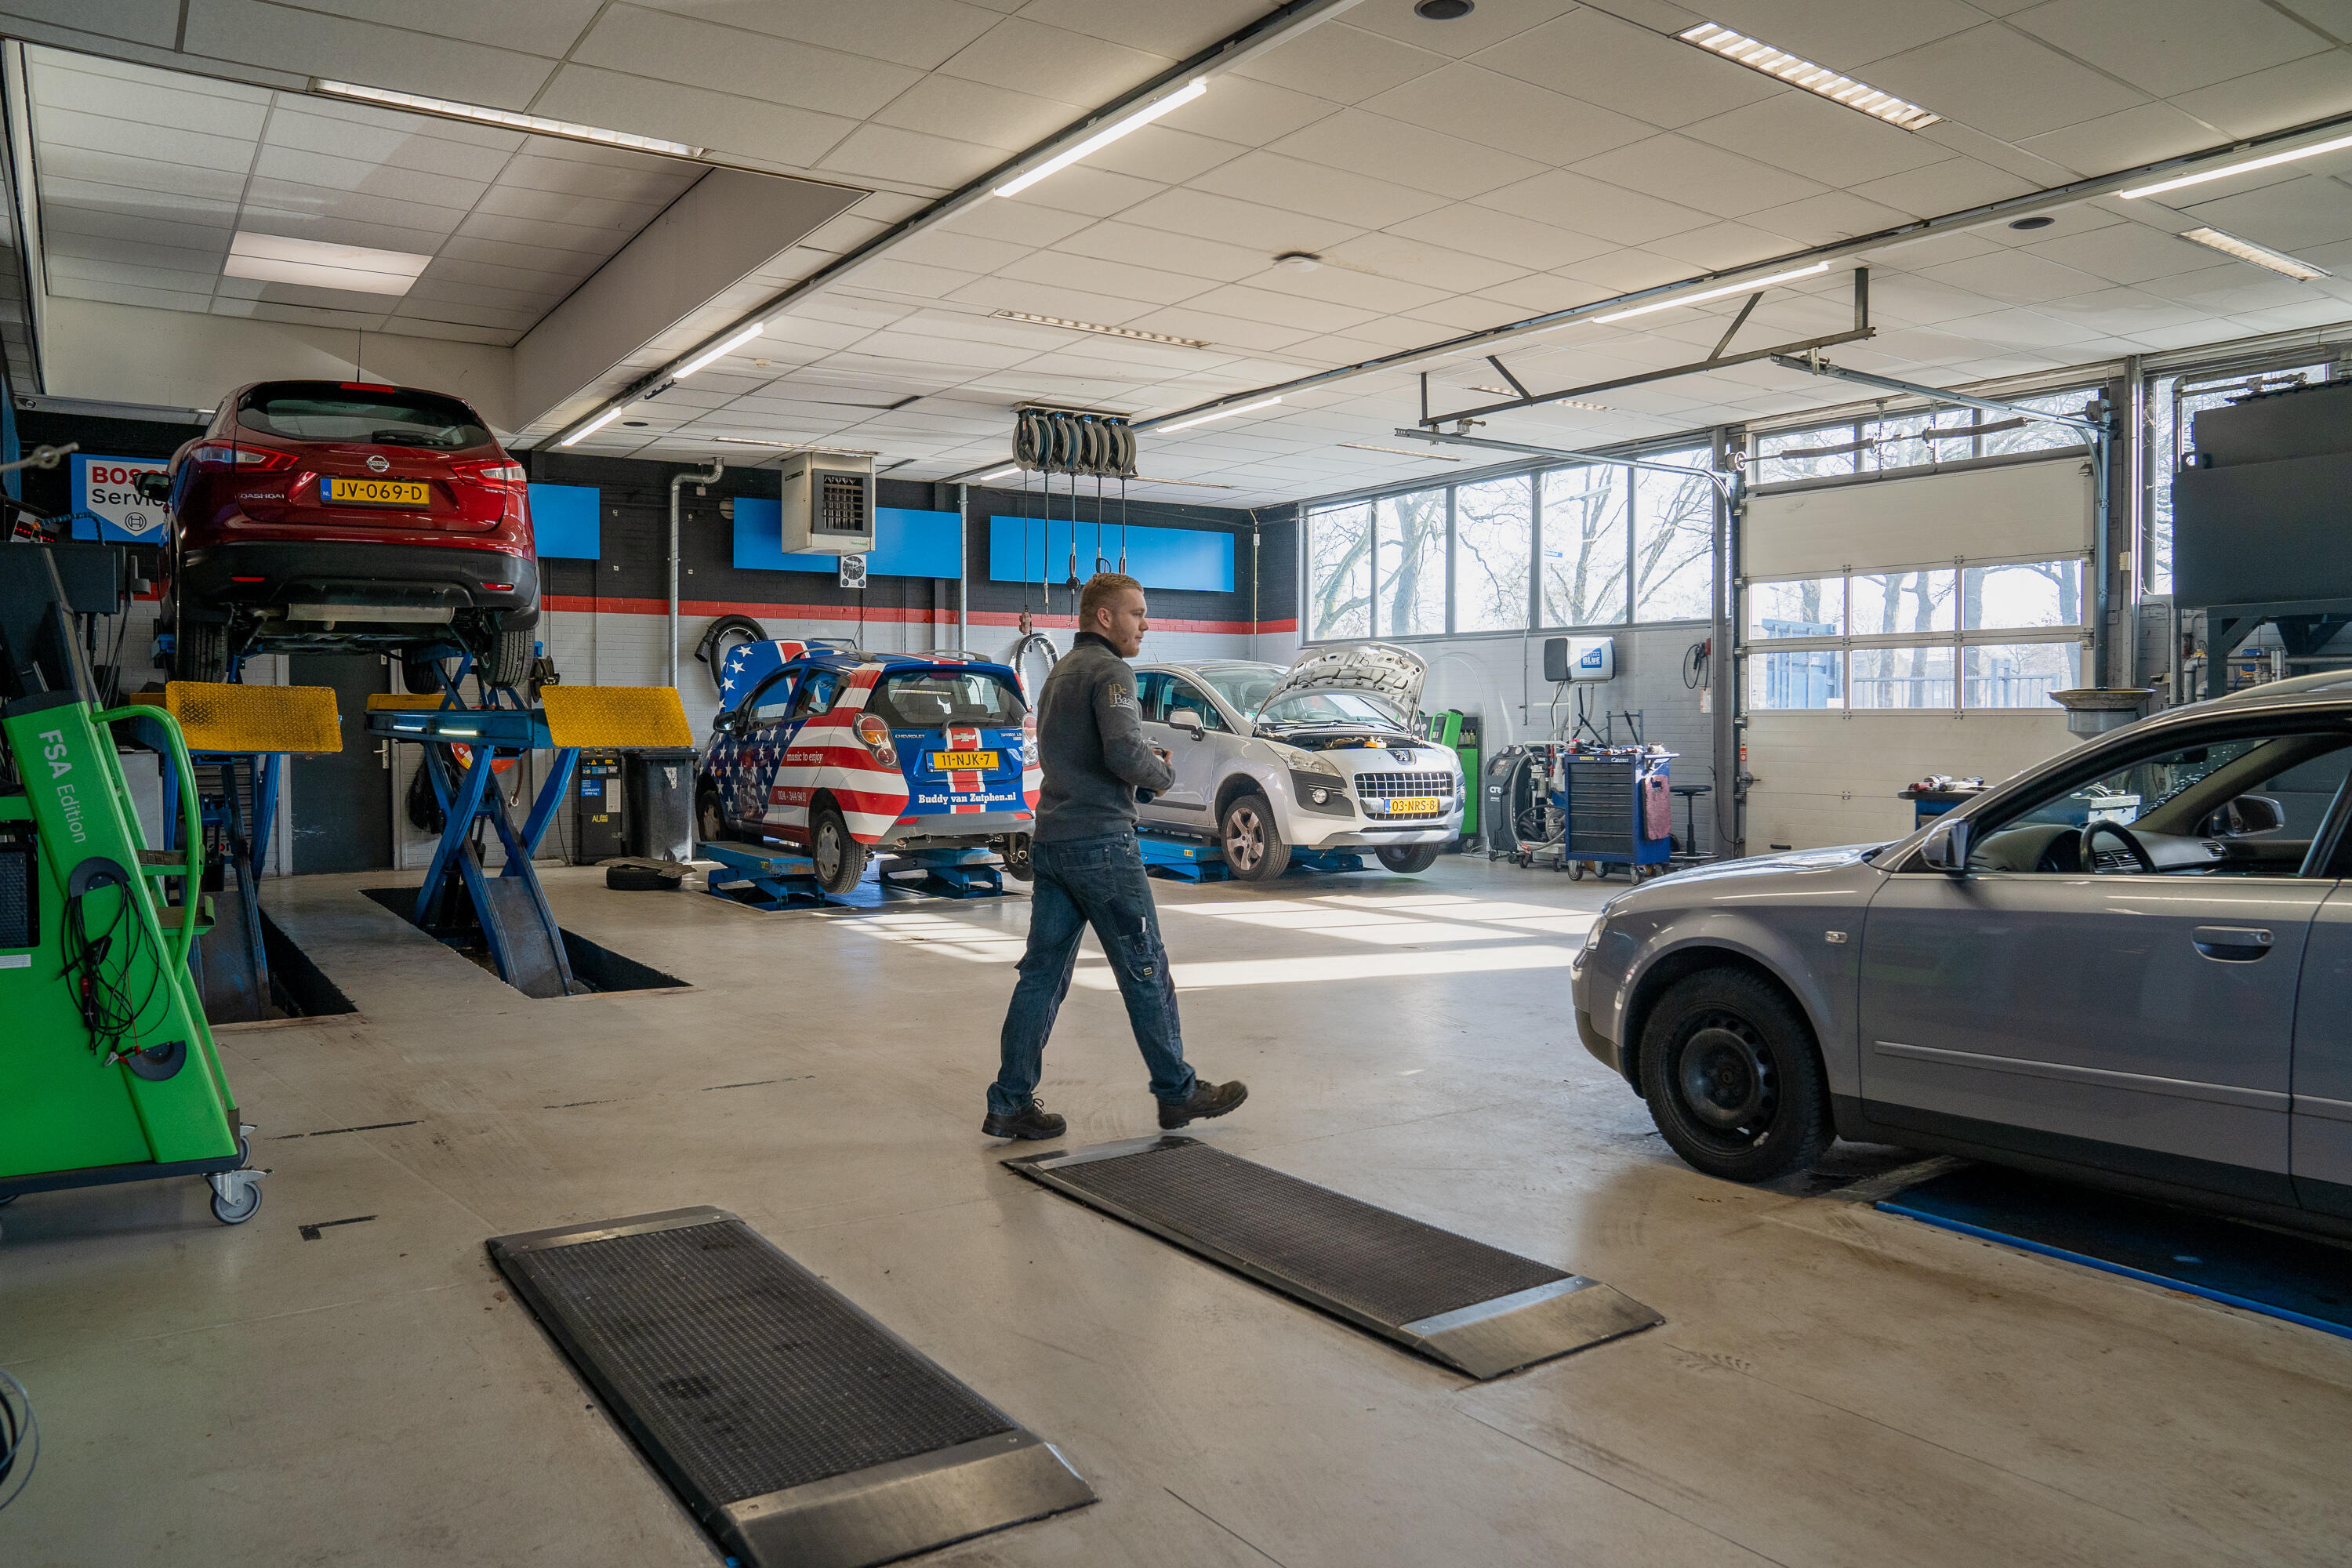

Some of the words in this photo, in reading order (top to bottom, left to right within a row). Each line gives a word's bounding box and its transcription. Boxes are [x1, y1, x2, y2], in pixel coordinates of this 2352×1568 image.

[92, 466, 167, 485] BOS
[92, 488, 164, 507] Servi
[336, 482, 423, 501] JV-069-D
[1112, 683, 1127, 695] De
[786, 750, 802, 761] music
[803, 751, 808, 761] to
[808, 750, 824, 764] enjoy
[941, 753, 990, 766] 11-NJK-7
[38, 729, 73, 779] FSA
[56, 783, 86, 844] Edition
[918, 793, 948, 805] Buddy
[969, 792, 1017, 804] Zutphen.nl
[1392, 800, 1436, 812] 03-NRS-8
